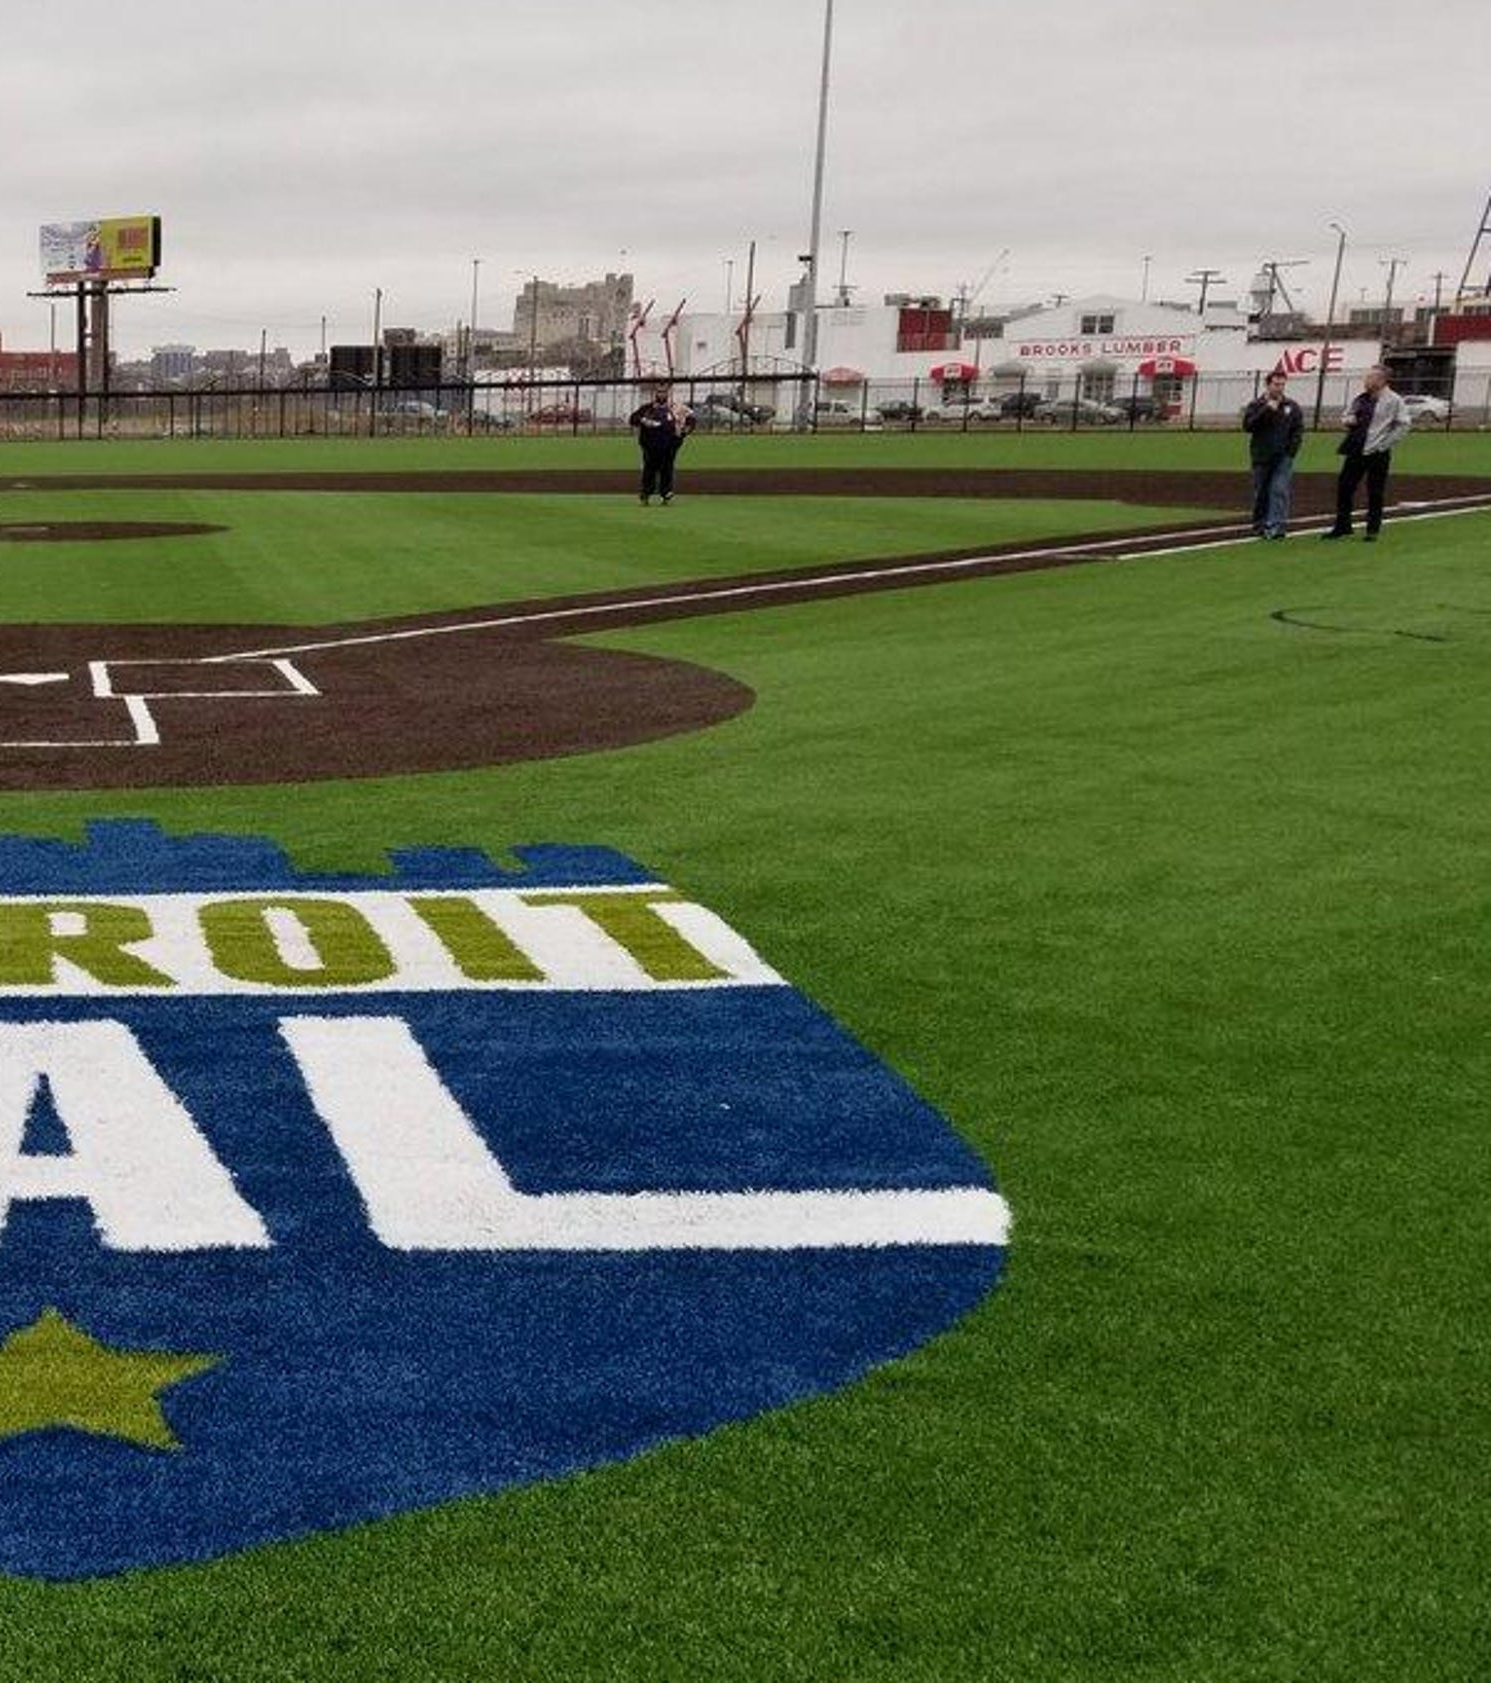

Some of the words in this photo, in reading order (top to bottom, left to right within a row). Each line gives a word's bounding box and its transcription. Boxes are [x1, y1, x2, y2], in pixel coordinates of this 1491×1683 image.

[1019, 343, 1092, 356] BROOKS
[1102, 339, 1182, 354] LUMBER
[1272, 347, 1344, 373] ACE
